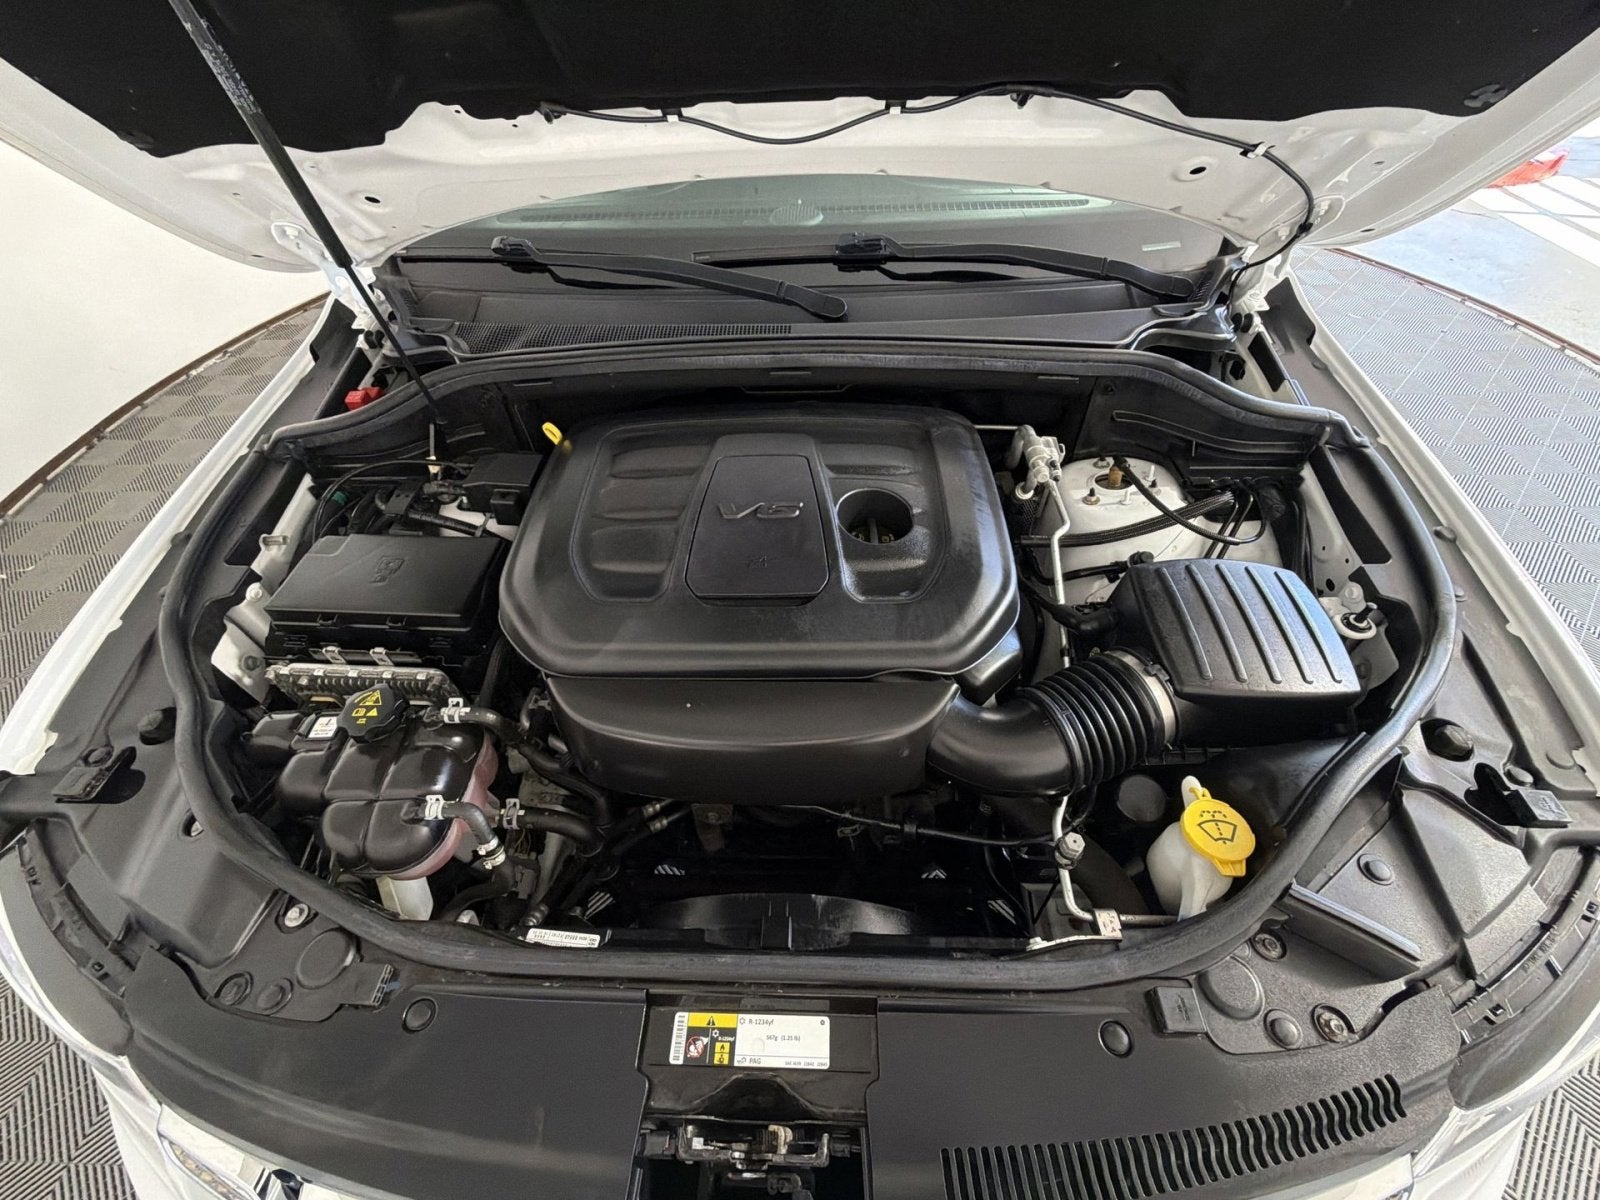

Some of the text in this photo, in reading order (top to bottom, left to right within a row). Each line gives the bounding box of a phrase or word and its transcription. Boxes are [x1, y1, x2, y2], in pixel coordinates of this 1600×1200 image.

[716, 501, 804, 519] V6
[748, 1018, 775, 1027] R-1234yf
[749, 1057, 762, 1065] PAG
